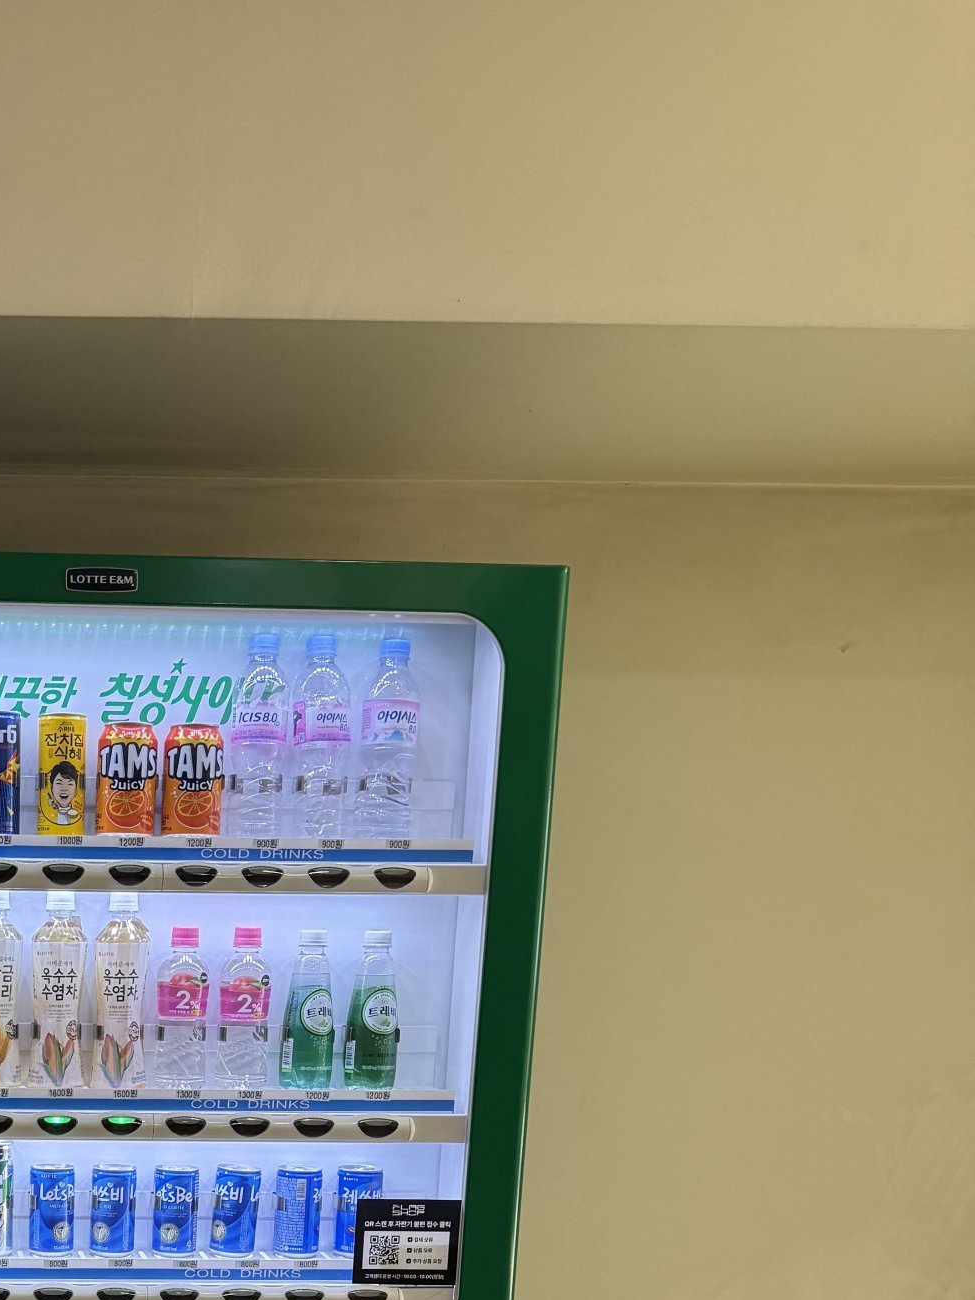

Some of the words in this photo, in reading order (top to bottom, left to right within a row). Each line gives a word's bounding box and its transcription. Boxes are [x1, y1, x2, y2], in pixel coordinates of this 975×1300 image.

[69, 574, 107, 584] LOTTE
[109, 575, 133, 584] E&M
[45, 733, 83, 747] 잔치집
[54, 746, 81, 760] 식혜
[100, 743, 157, 779] TAMS
[168, 744, 224, 779] TAMS
[111, 779, 145, 791] Juicy
[179, 779, 214, 791] Juicy
[59, 837, 83, 845] 1000원
[119, 838, 144, 847] 1200원
[188, 838, 212, 847] 1200원
[257, 840, 277, 848] 900원
[201, 848, 250, 860] COLD
[260, 849, 324, 860] DRINKS
[42, 968, 78, 984] 옥수수
[103, 969, 139, 984] 옥수수
[42, 984, 77, 1001] 수염차
[103, 985, 138, 1001] 수염차
[49, 1089, 73, 1097] 1600원
[113, 1090, 137, 1098] 1600원
[176, 1090, 200, 1098] 1300원
[238, 1091, 262, 1099] 1300원
[306, 1092, 329, 1100] 1200원
[367, 1092, 390, 1100] 1200원
[191, 1099, 237, 1109] COLD
[248, 1100, 310, 1109] DRINKS
[185, 1269, 230, 1278] COLD
[241, 1269, 301, 1278] DRINKS
